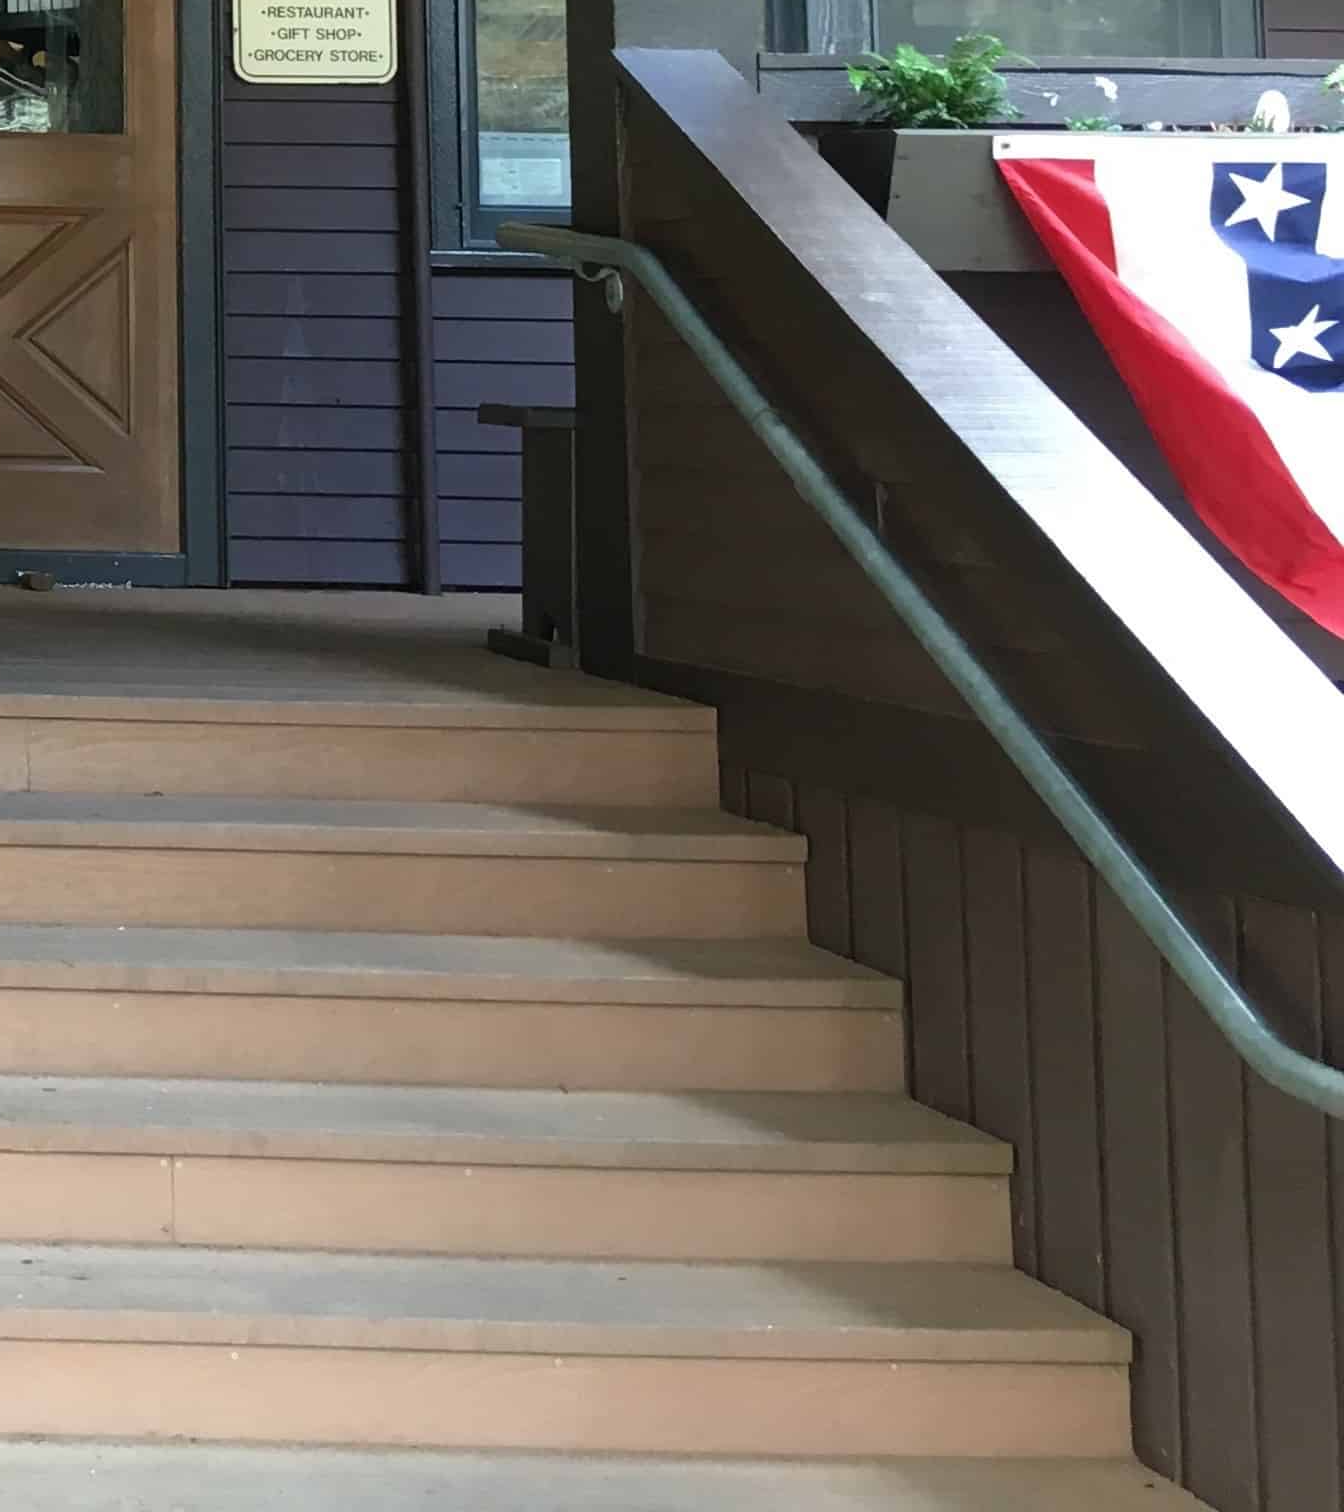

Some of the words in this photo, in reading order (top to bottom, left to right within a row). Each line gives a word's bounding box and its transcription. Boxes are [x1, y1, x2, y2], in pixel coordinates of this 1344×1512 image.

[268, 6, 364, 18] RESTAURANT
[277, 28, 310, 40] GIFT
[316, 28, 356, 40] SHOP
[254, 49, 323, 61] GROCERY
[330, 50, 377, 62] STORE
